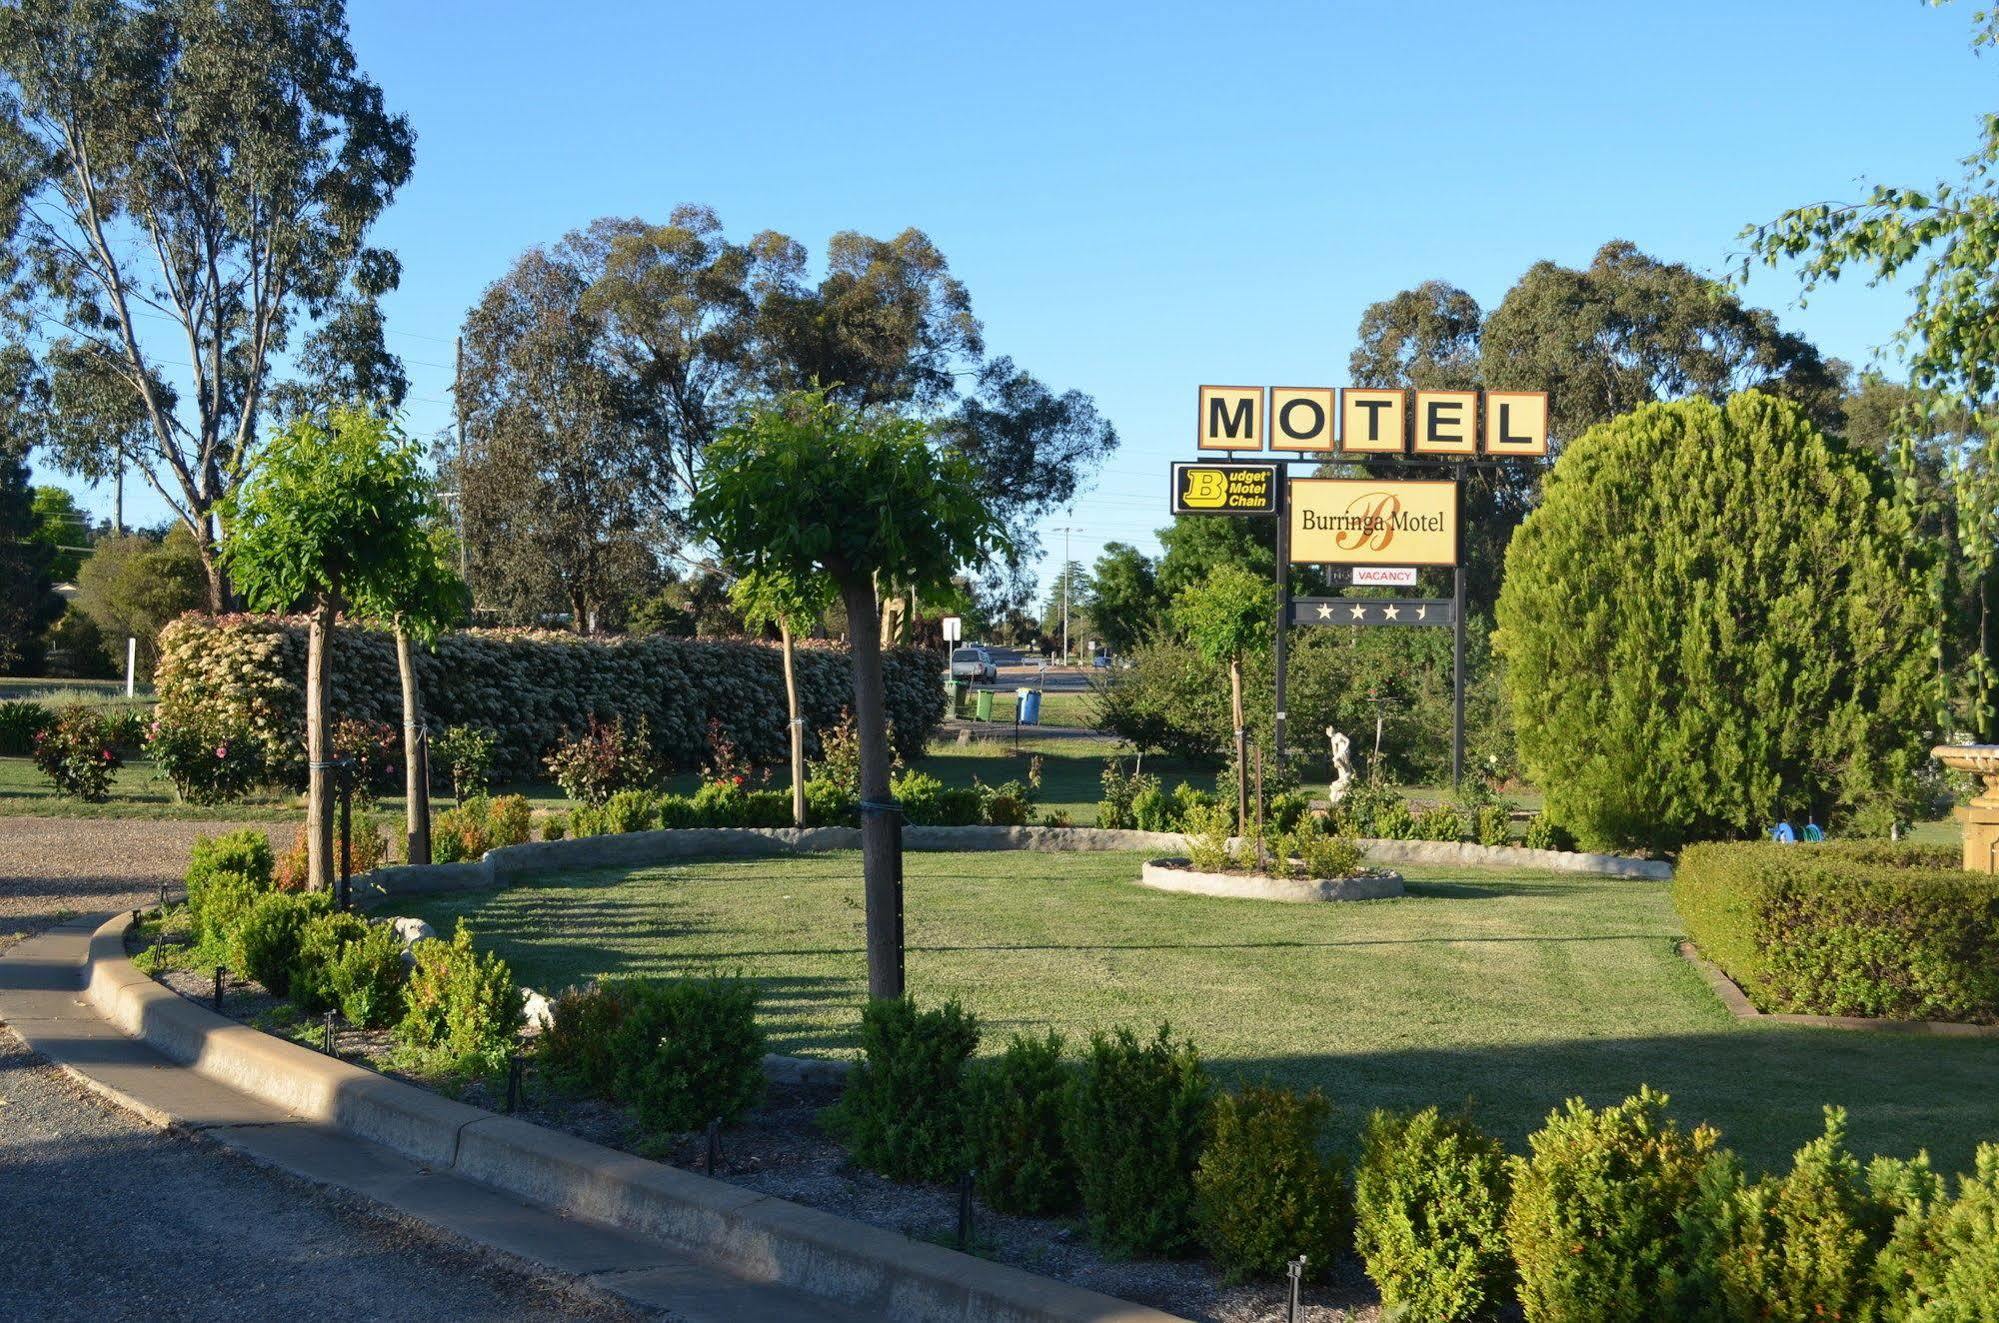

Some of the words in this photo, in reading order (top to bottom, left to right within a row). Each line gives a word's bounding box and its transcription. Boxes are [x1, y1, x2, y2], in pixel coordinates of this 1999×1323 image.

[1209, 397, 1533, 443] MOTEL
[1229, 483, 1267, 494] Motel
[1229, 495, 1266, 507] Chain
[1302, 509, 1385, 536] Burringa
[1391, 511, 1444, 532] Motel
[1358, 571, 1412, 581] VACANCY
